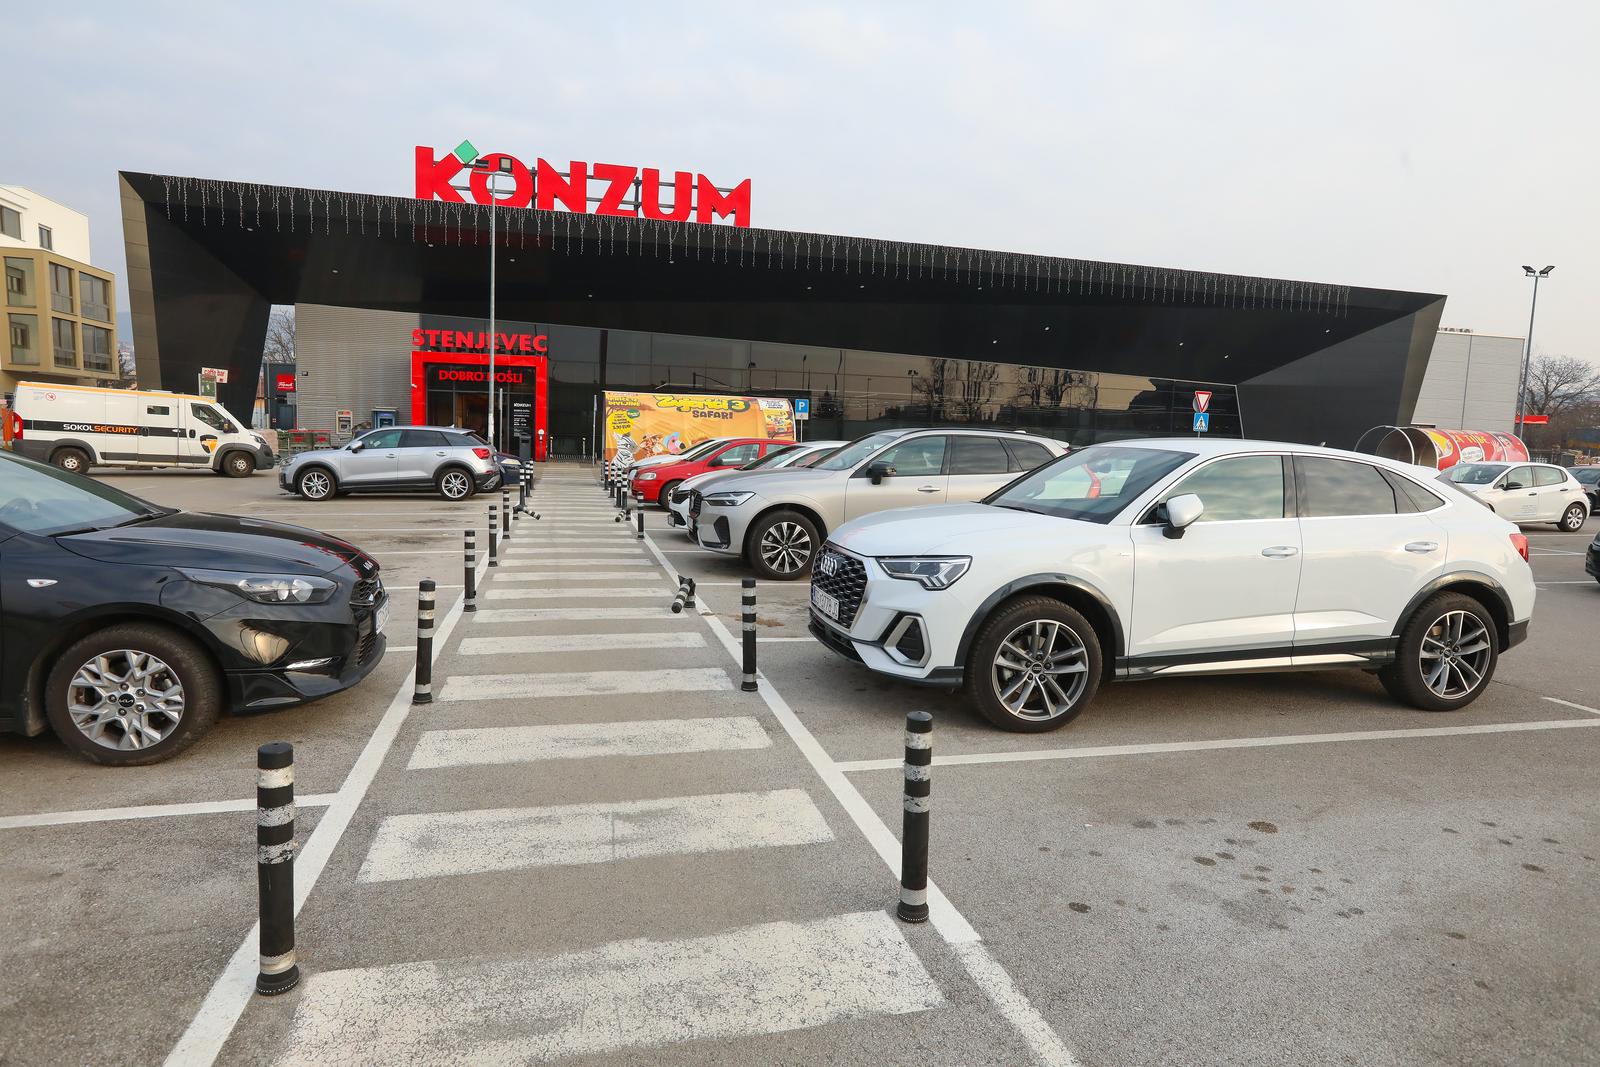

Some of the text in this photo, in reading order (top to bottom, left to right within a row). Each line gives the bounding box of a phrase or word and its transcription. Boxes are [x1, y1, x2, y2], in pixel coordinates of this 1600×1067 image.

[415, 145, 751, 228] KONZUM
[411, 328, 548, 352] STENJEVEC
[438, 369, 485, 381] DOBRO
[798, 402, 806, 411] P
[692, 410, 733, 419] SAFARI
